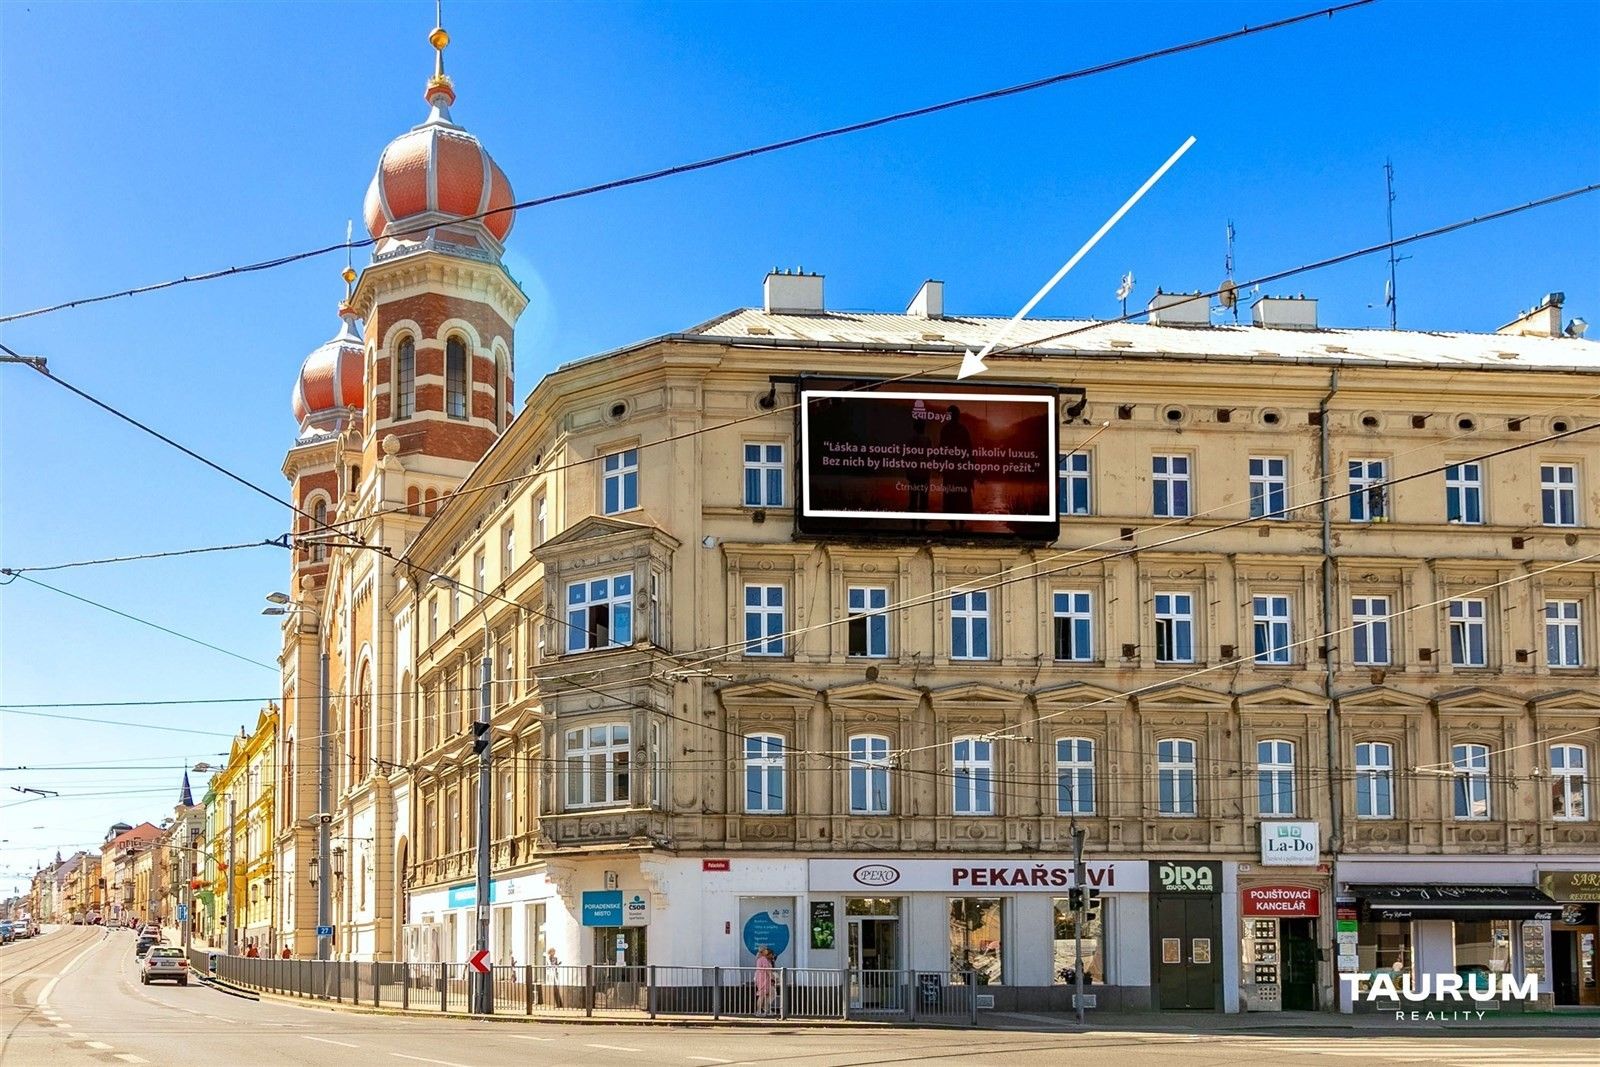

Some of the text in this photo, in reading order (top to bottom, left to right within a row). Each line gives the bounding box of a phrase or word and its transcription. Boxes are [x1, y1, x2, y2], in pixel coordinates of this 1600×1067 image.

[860, 445, 867, 453] a
[869, 444, 900, 454] soucit
[902, 444, 924, 457] jsou
[926, 446, 969, 458] potřeby,
[971, 447, 1006, 457] nikoliv
[1008, 448, 1038, 459] luxus.
[822, 456, 840, 466] Bez
[842, 457, 865, 467] nich
[867, 457, 880, 470] by
[882, 458, 918, 469] lidstvo
[920, 460, 955, 473] nebylo
[957, 461, 1001, 474] schopno
[1269, 839, 1313, 851] La-Do
[860, 869, 895, 881] PEKO
[1251, 889, 1311, 899] POJIŠŤOVACÍ
[1256, 901, 1306, 910] KANCELÁŘ
